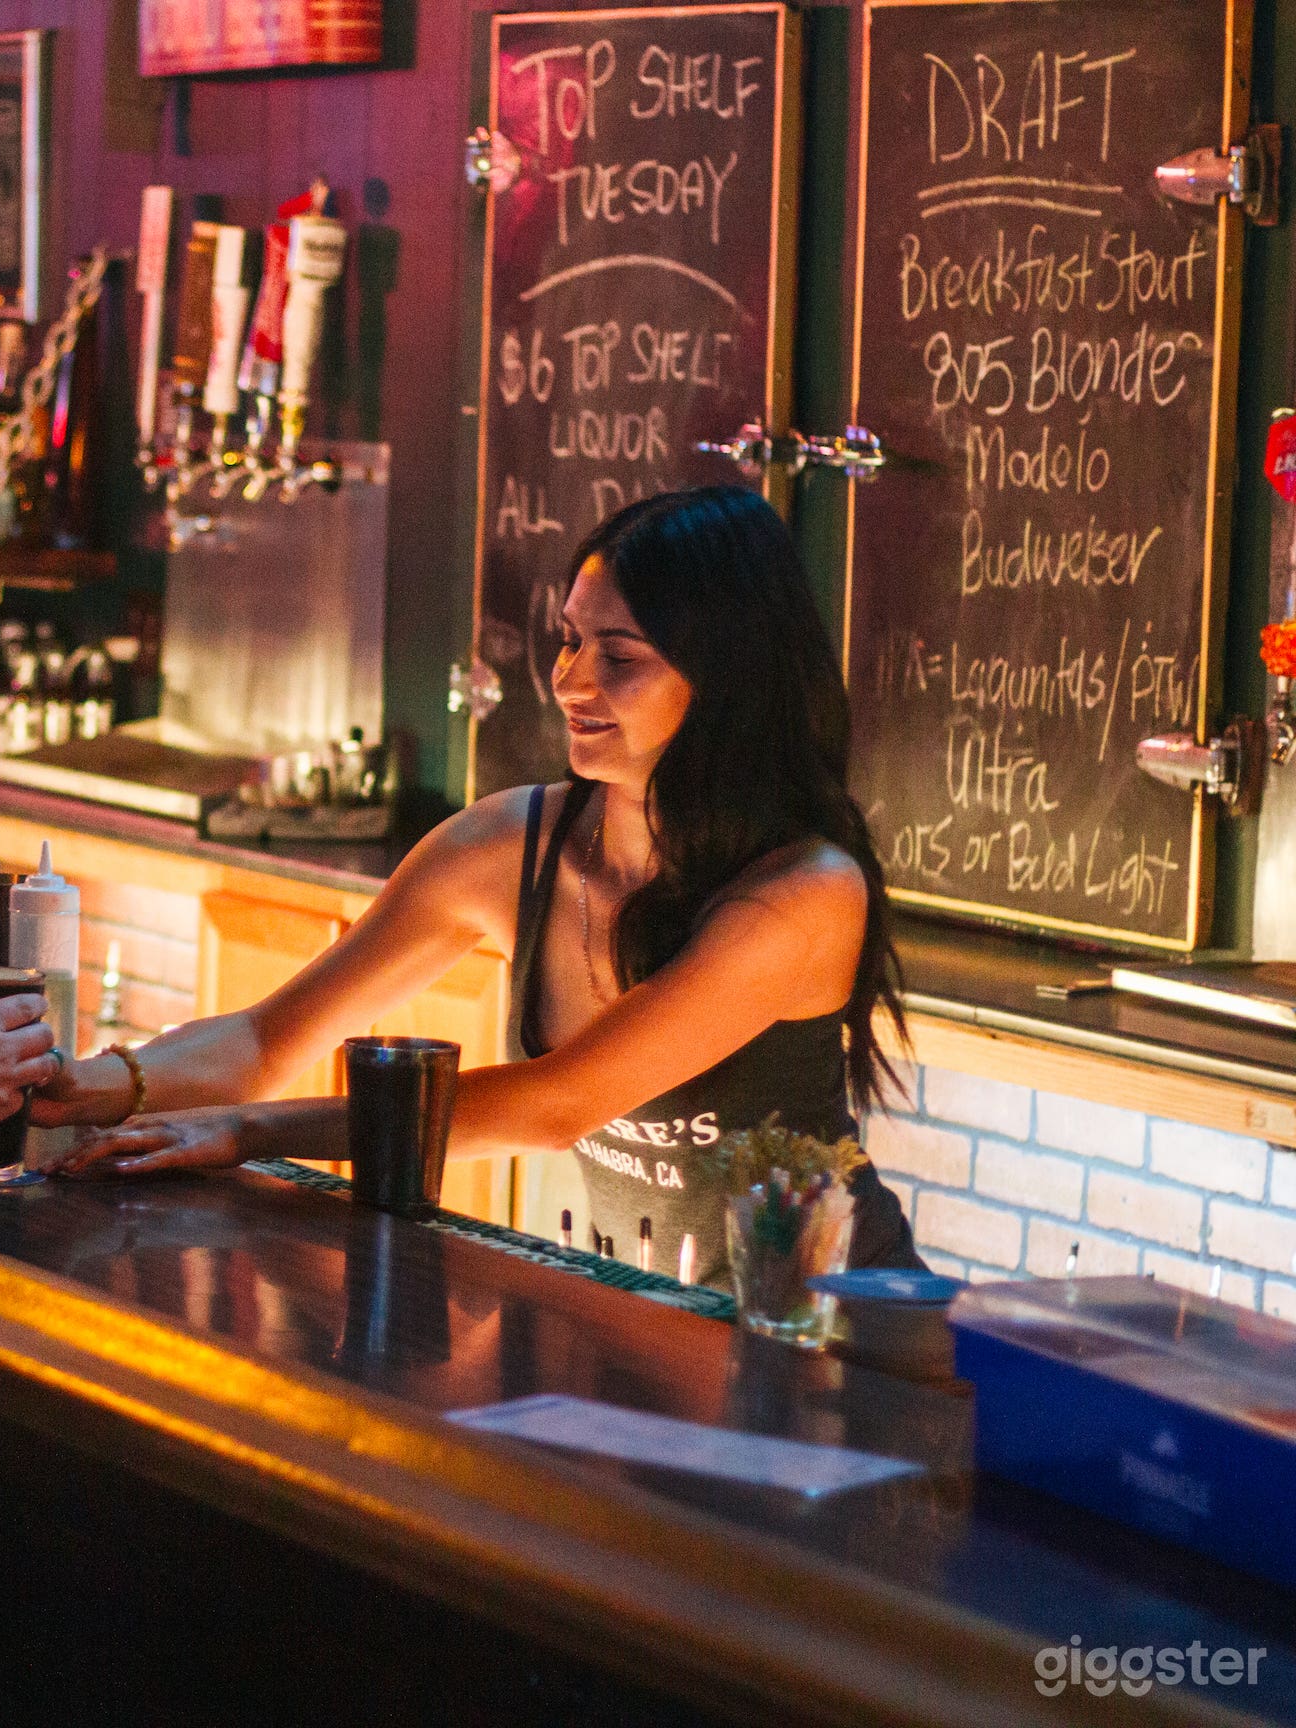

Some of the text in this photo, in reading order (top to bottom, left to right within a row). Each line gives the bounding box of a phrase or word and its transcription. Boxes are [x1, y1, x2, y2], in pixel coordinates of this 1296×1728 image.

[511, 39, 762, 155] TOP SHELF
[924, 48, 1136, 163] DRAFT
[548, 152, 737, 245] TUESDAY
[901, 225, 1207, 321] Breakfast Stout
[562, 321, 621, 394] TOP
[924, 321, 1186, 415] 805 Blonde
[550, 406, 668, 463] LIQUOR
[962, 508, 1163, 596] Budweiser
[947, 722, 1059, 816] Ultra
[962, 831, 1002, 873] or
[1007, 820, 1076, 892] Bud
[1085, 827, 1179, 914] Light
[604, 1112, 720, 1147] RE'S
[656, 1161, 684, 1189] CA
